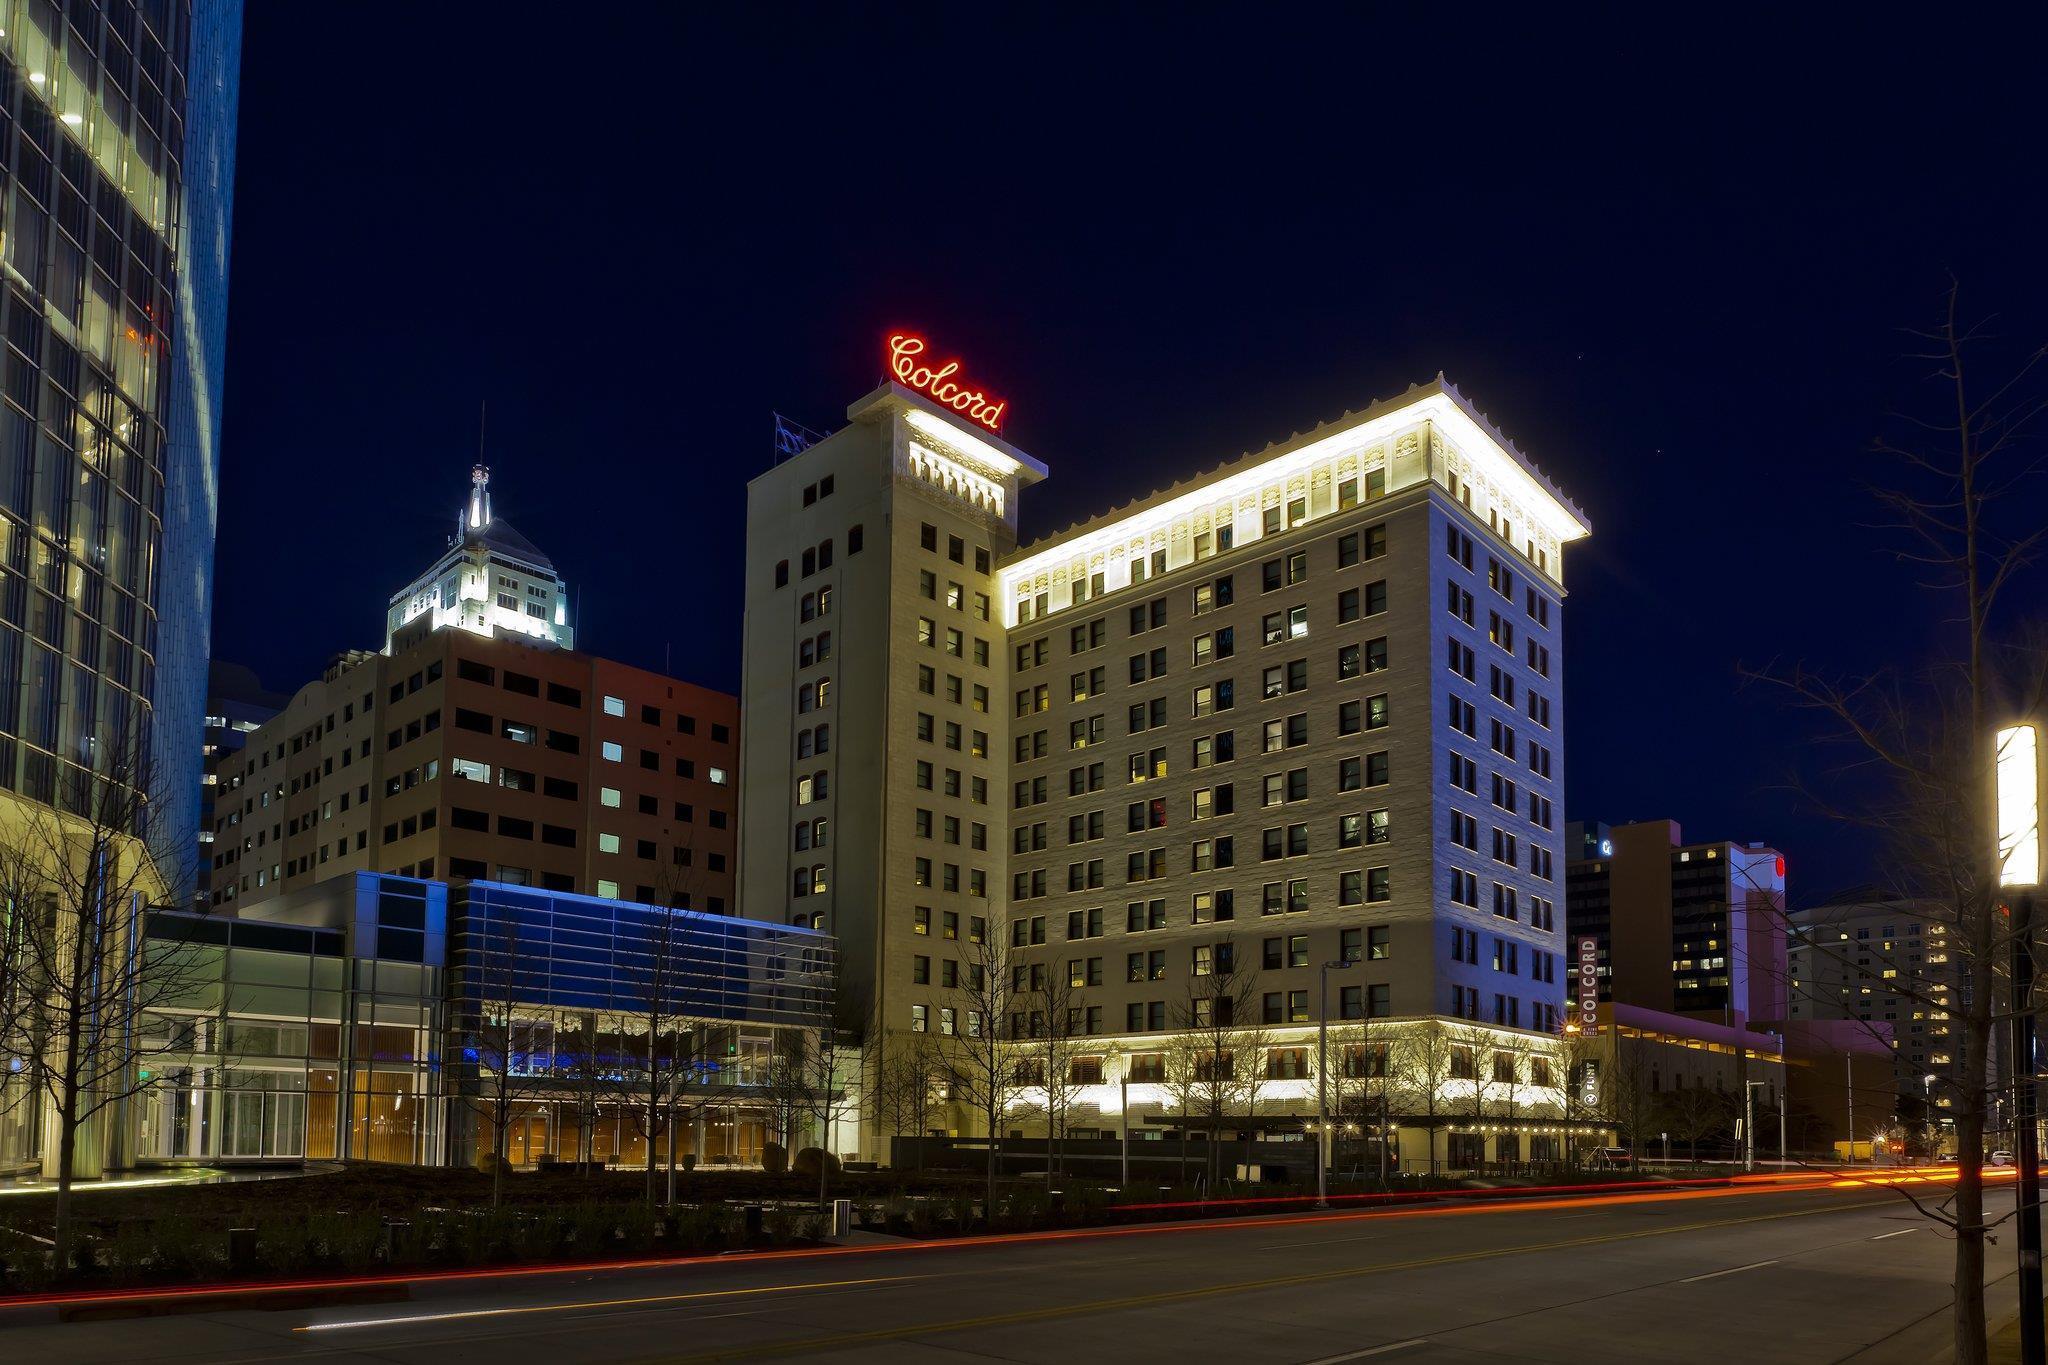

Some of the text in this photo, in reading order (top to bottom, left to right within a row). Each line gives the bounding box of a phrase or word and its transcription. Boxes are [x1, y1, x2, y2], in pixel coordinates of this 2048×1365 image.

[890, 335, 1005, 429] Colcord
[1582, 940, 1597, 1023] COLCORD
[1586, 1062, 1595, 1090] FLINT
